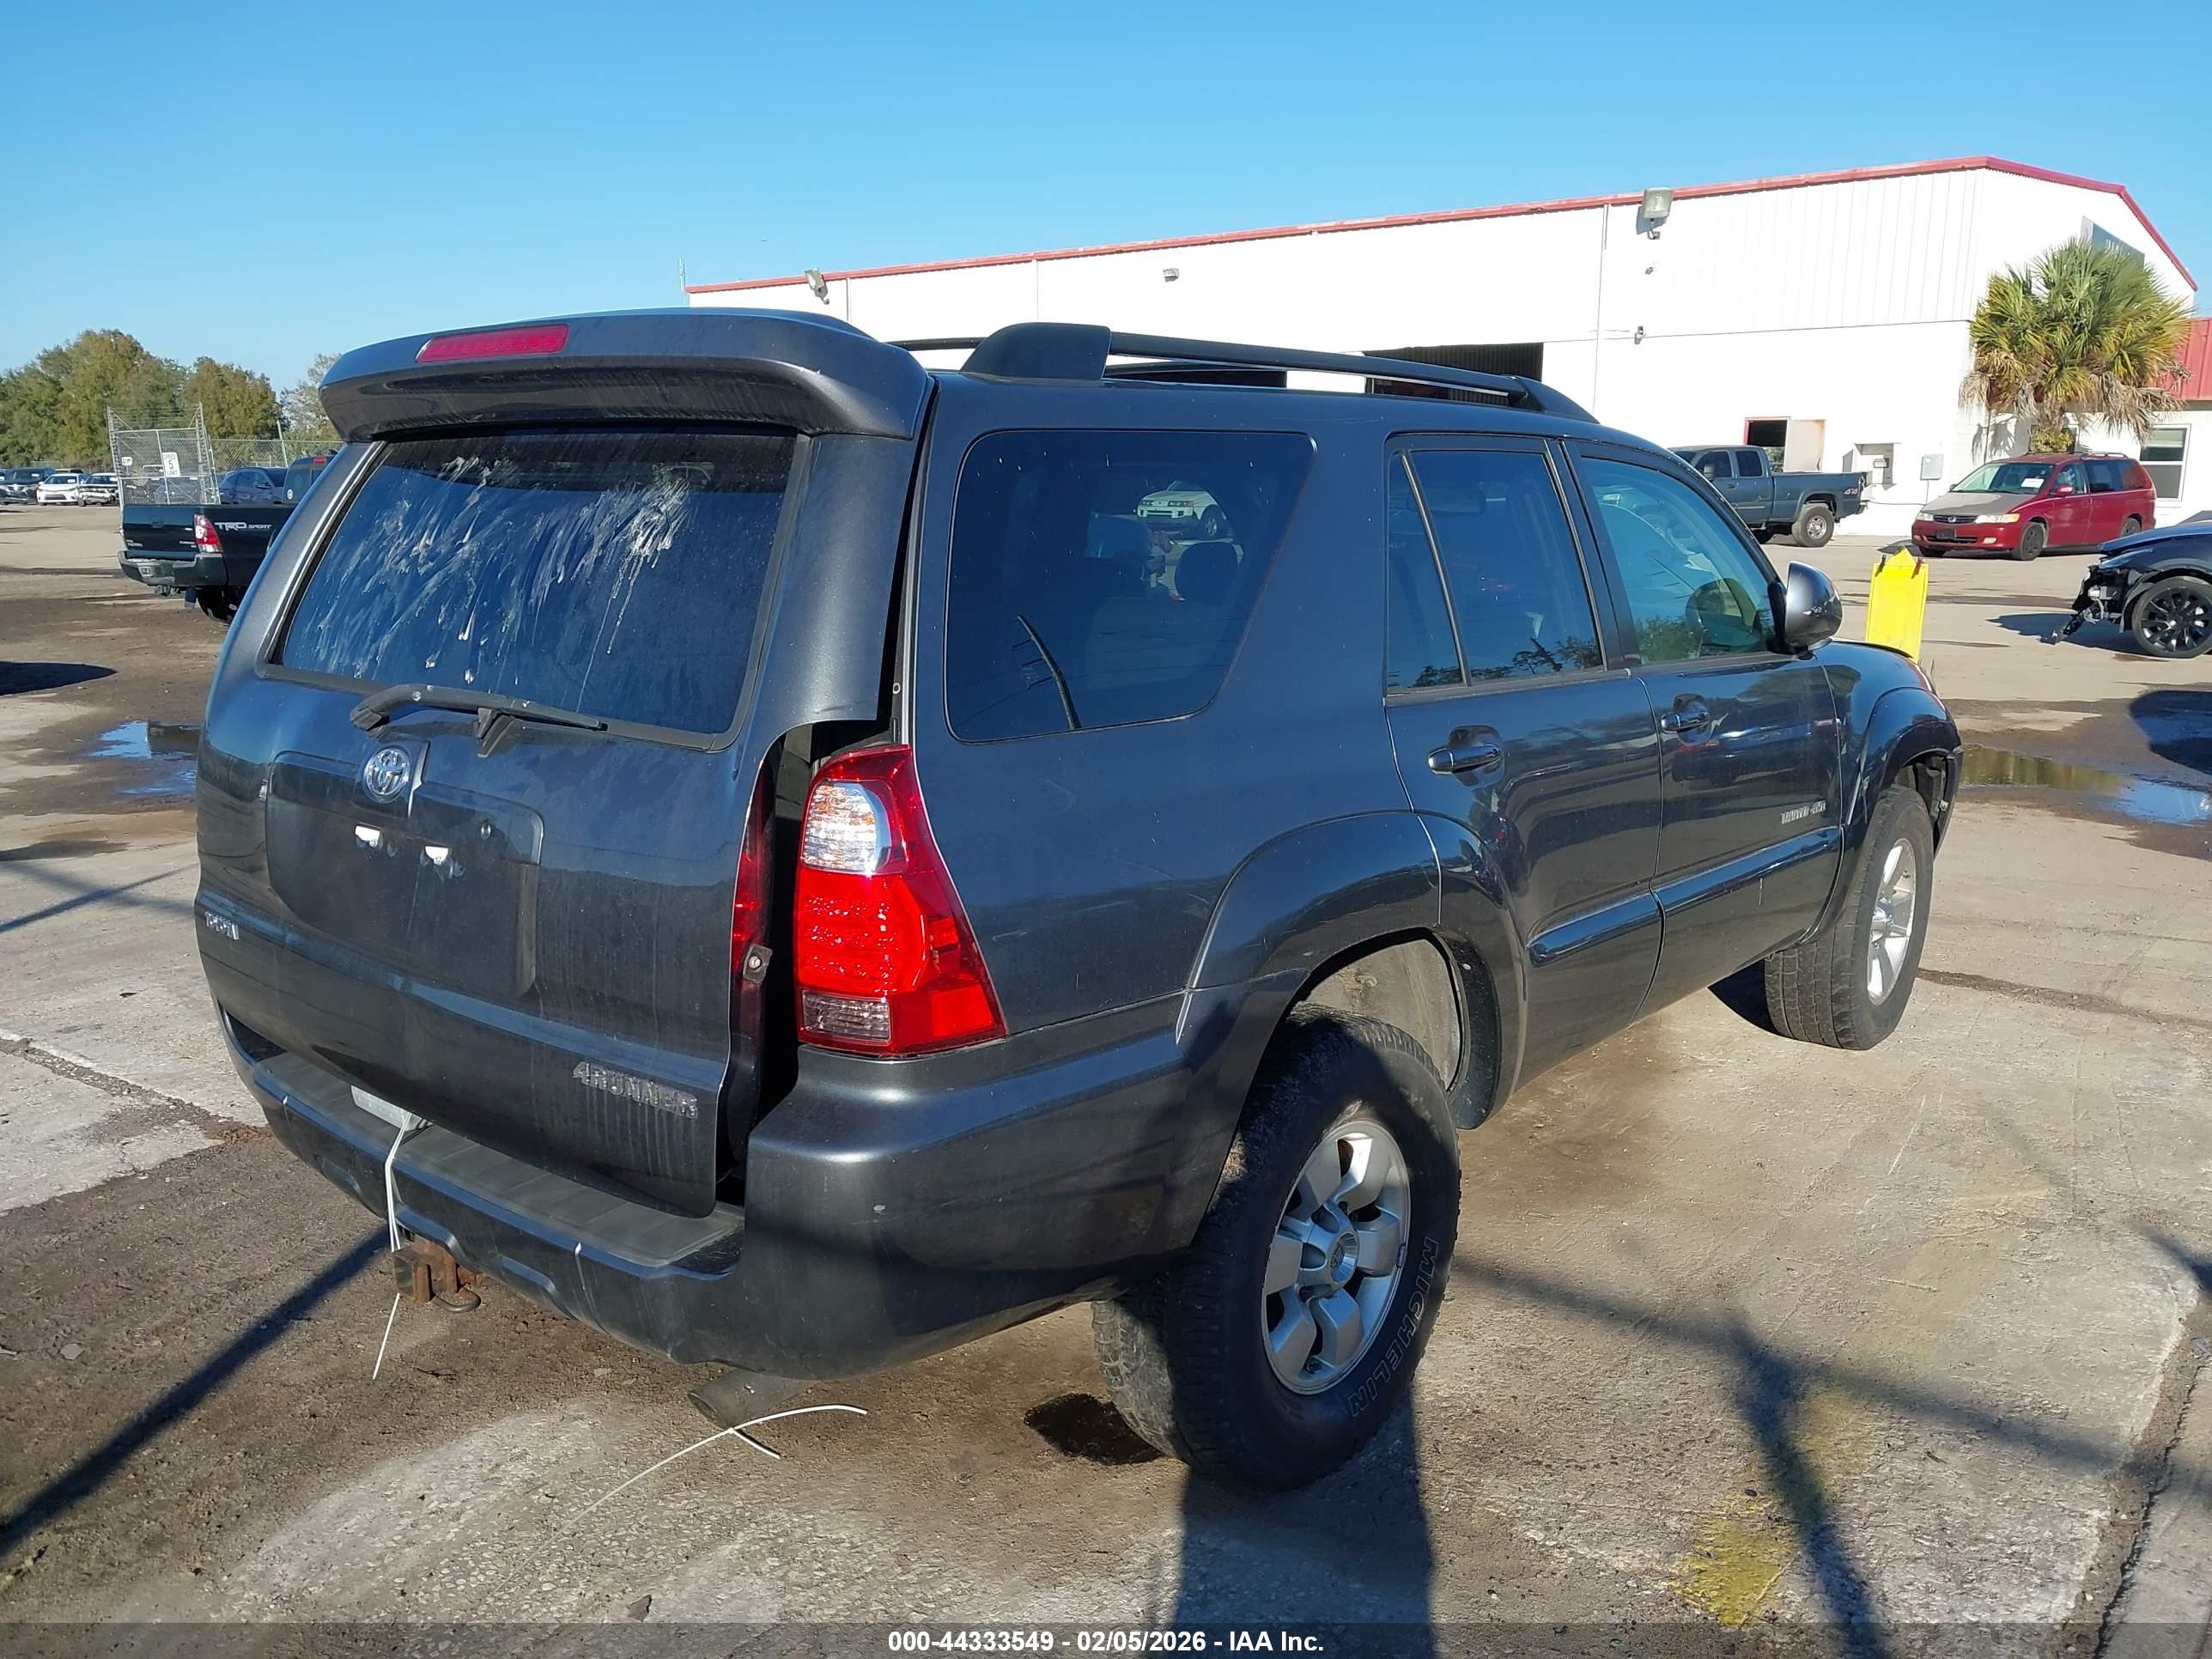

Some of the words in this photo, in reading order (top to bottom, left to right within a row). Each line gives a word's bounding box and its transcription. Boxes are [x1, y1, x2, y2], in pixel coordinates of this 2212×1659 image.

[168, 460, 173, 470] 5
[214, 522, 247, 532] TRD
[572, 1061, 697, 1119] 4RUNNER
[1346, 1237, 1439, 1417] MICHELIN
